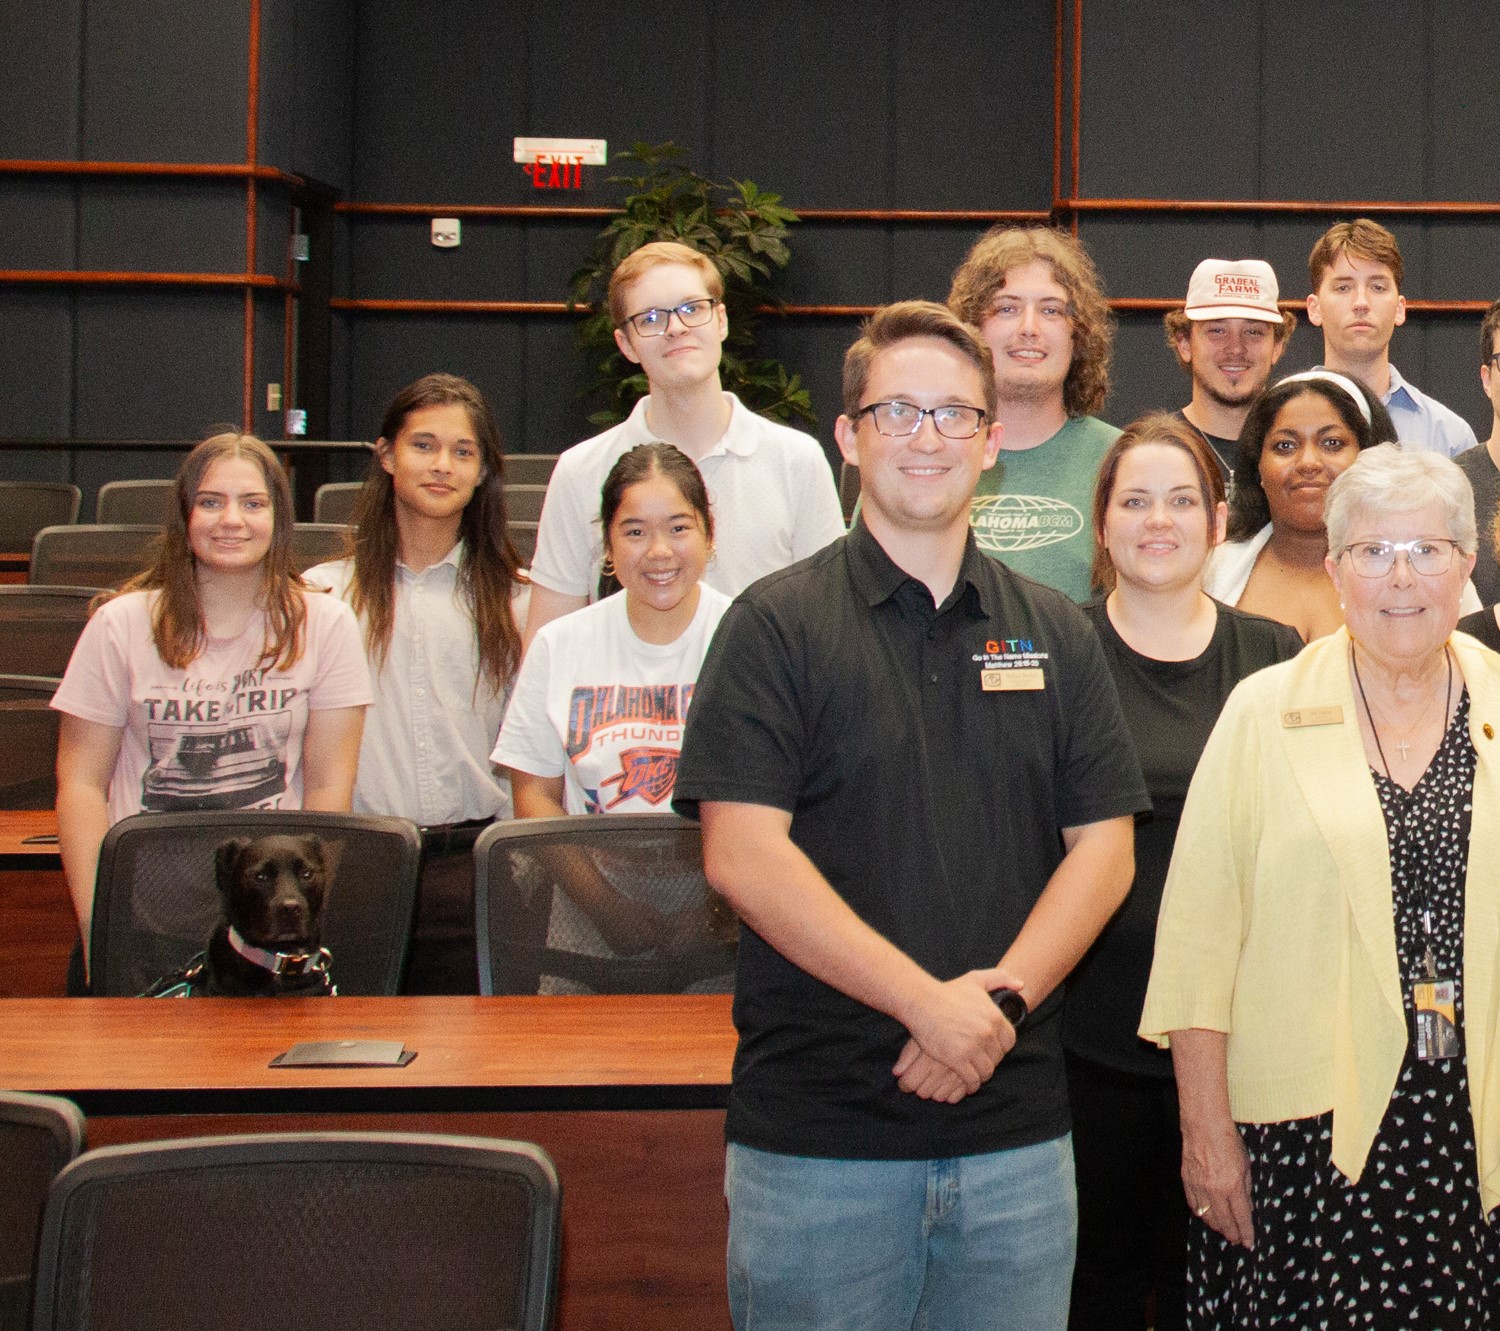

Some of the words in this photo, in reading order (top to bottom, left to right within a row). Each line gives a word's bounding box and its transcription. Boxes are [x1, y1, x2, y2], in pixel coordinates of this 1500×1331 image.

[533, 154, 583, 189] EXIT
[1214, 274, 1260, 287] GRABEAL
[1218, 284, 1260, 294] FARMS
[985, 639, 1034, 653] GITN
[984, 661, 1013, 669] Matthew
[144, 698, 222, 722] TAKE
[234, 687, 299, 715] TRIP
[566, 683, 680, 766] OKLAHOMA
[595, 727, 680, 747] THUND
